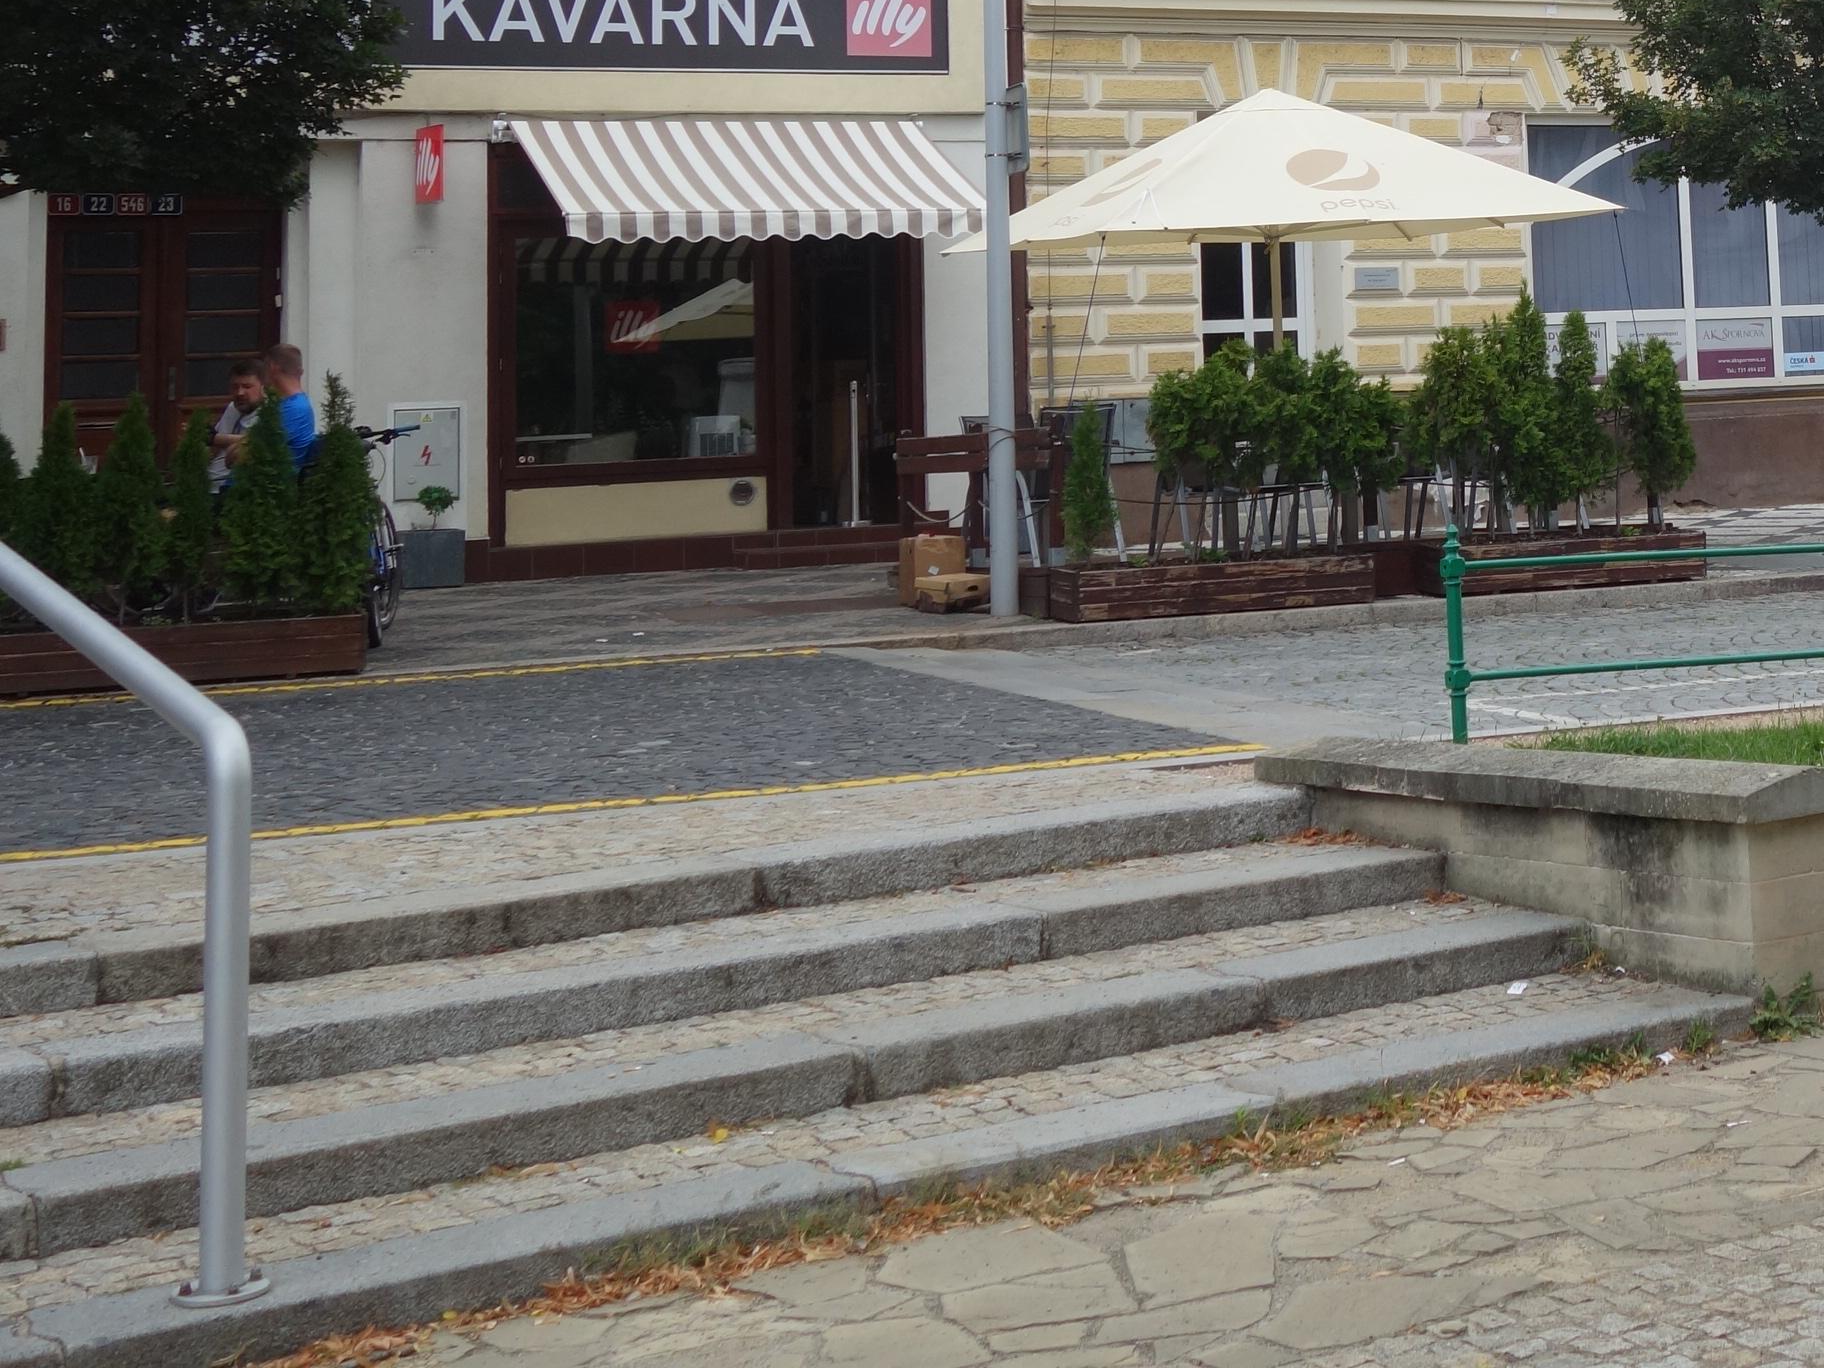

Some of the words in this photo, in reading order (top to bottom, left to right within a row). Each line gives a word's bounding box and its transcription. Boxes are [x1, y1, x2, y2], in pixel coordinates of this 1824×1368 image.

[416, 137, 440, 195] illy
[56, 197, 72, 211] 16
[90, 197, 107, 211] 22
[1320, 198, 1396, 213] pepsi
